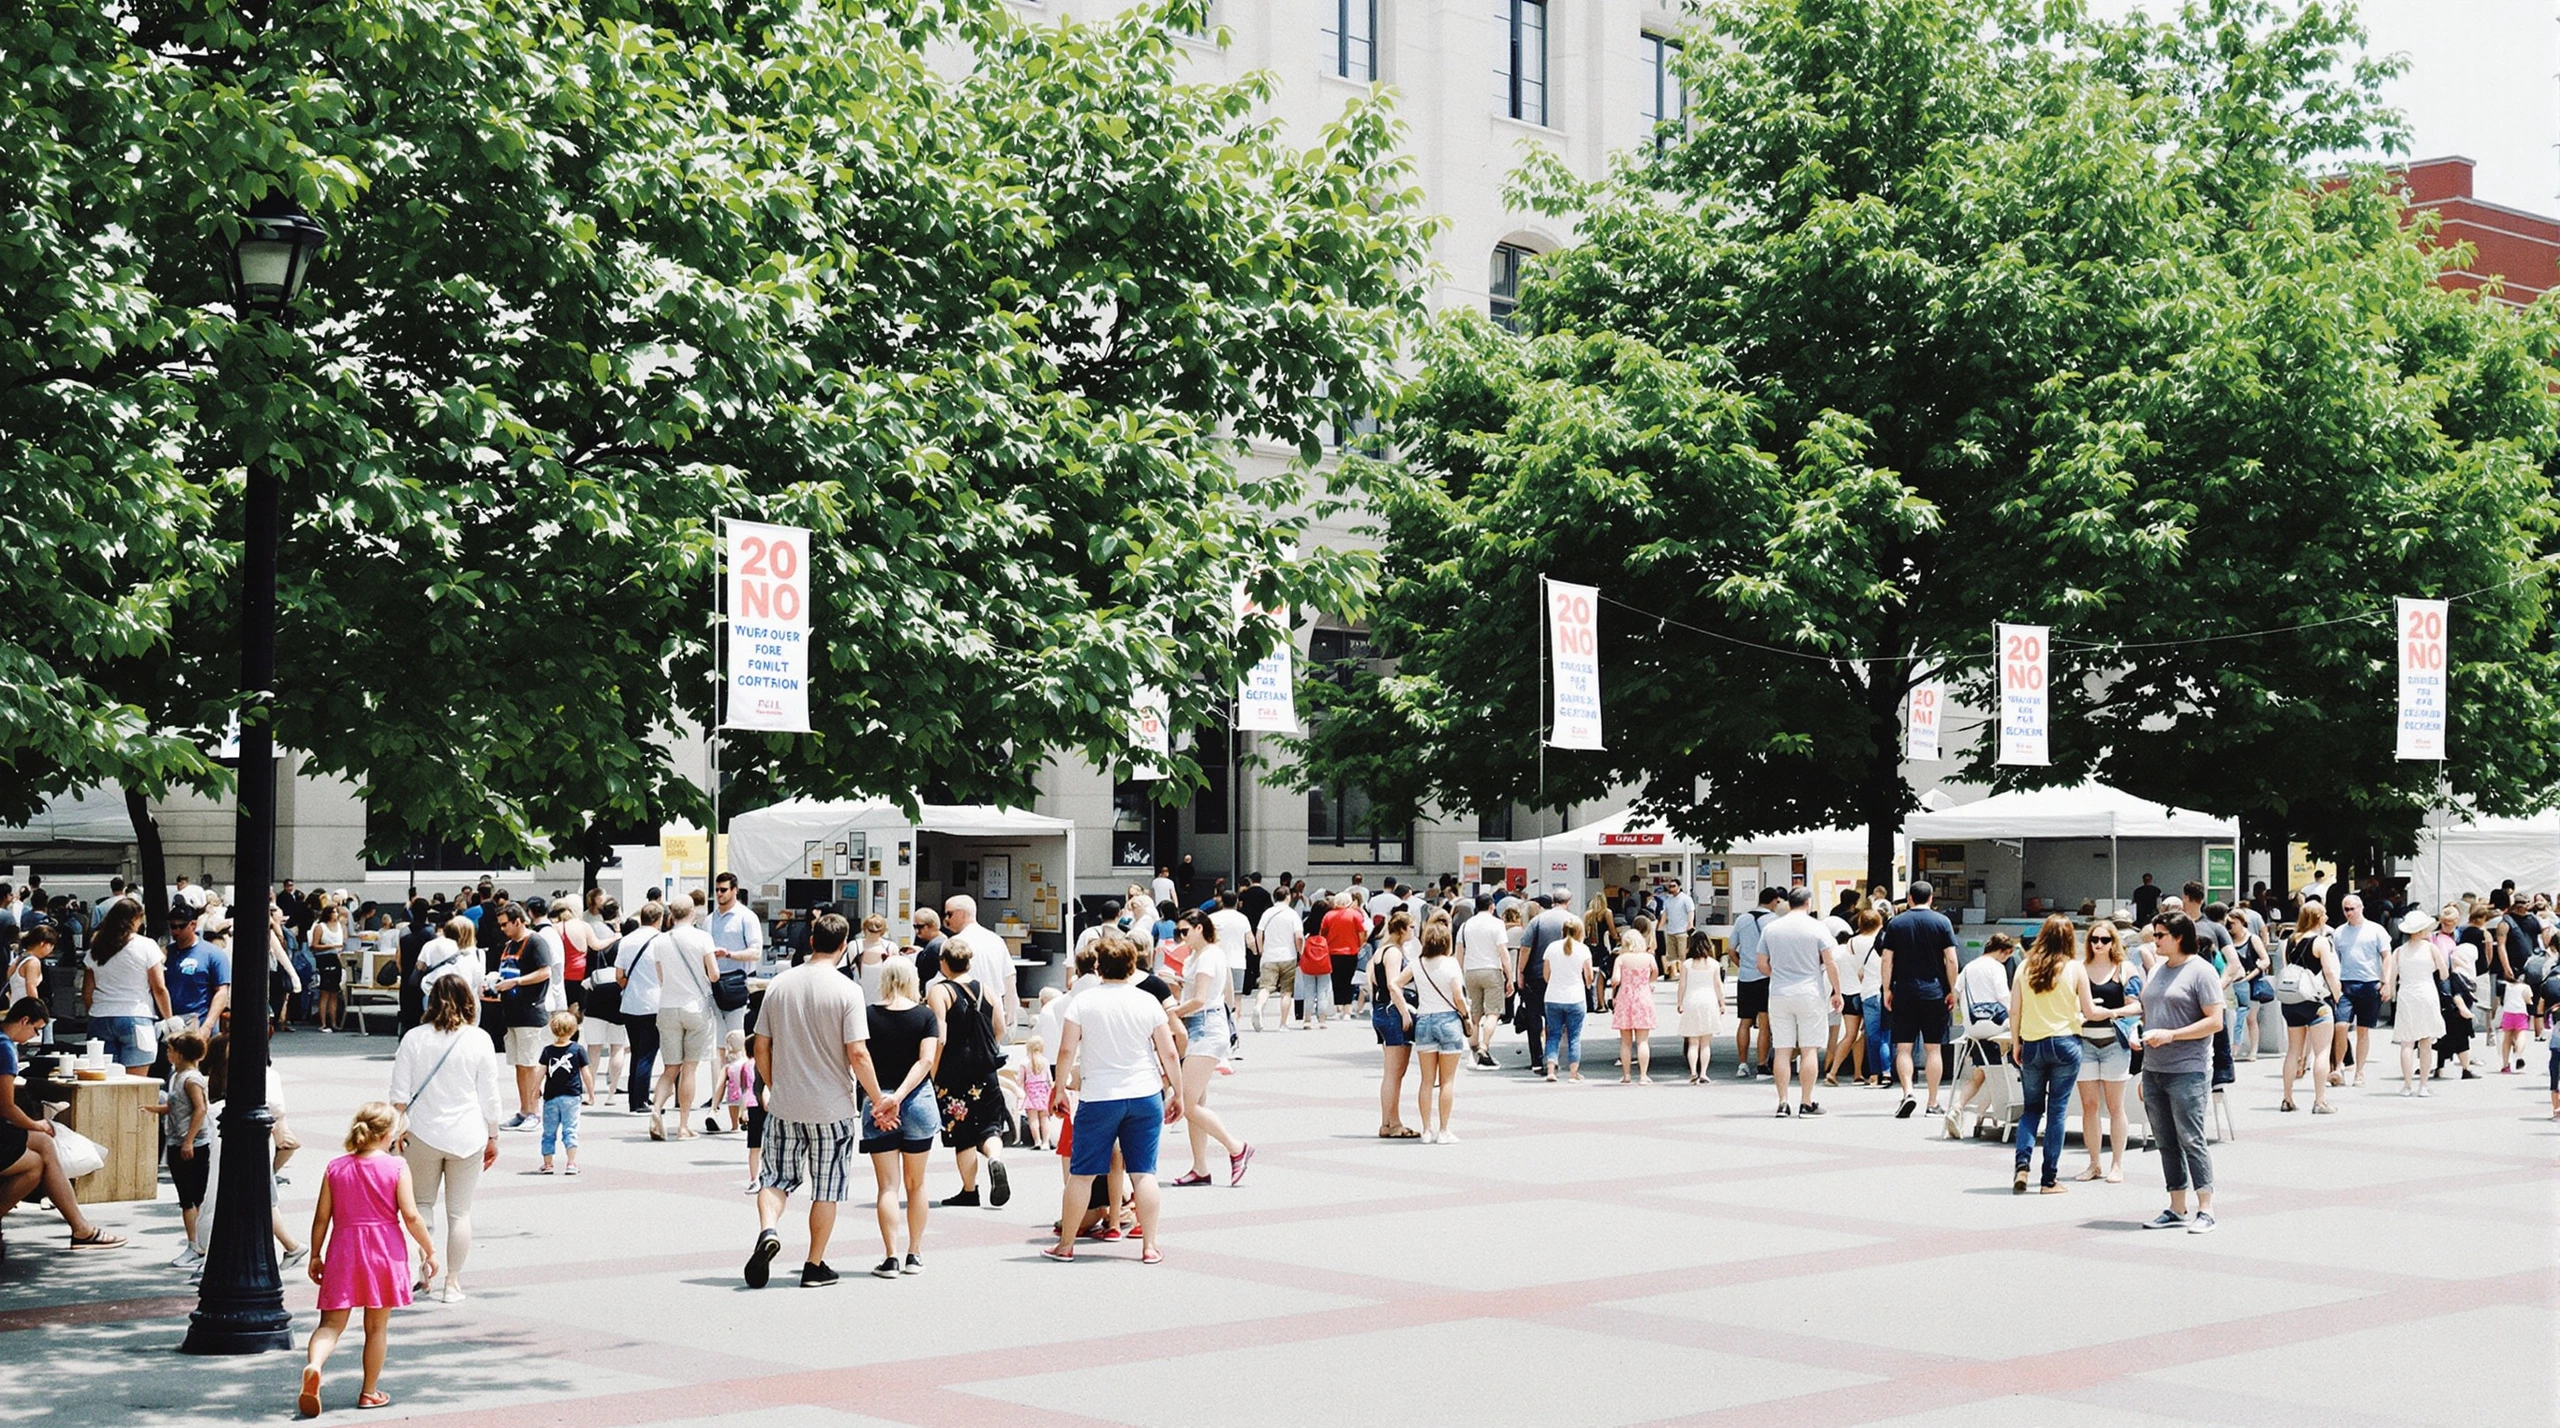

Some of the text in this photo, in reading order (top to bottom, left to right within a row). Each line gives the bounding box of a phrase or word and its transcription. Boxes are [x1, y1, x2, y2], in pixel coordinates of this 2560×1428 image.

[741, 536, 797, 580] 20
[741, 579, 800, 621] NO
[1557, 594, 1591, 624] 20
[2409, 610, 2442, 640] 20
[755, 644, 782, 656] FORE
[1560, 625, 1593, 656] NO
[2008, 635, 2041, 662] 20
[2408, 642, 2442, 670] NO
[2008, 664, 2043, 690] NO
